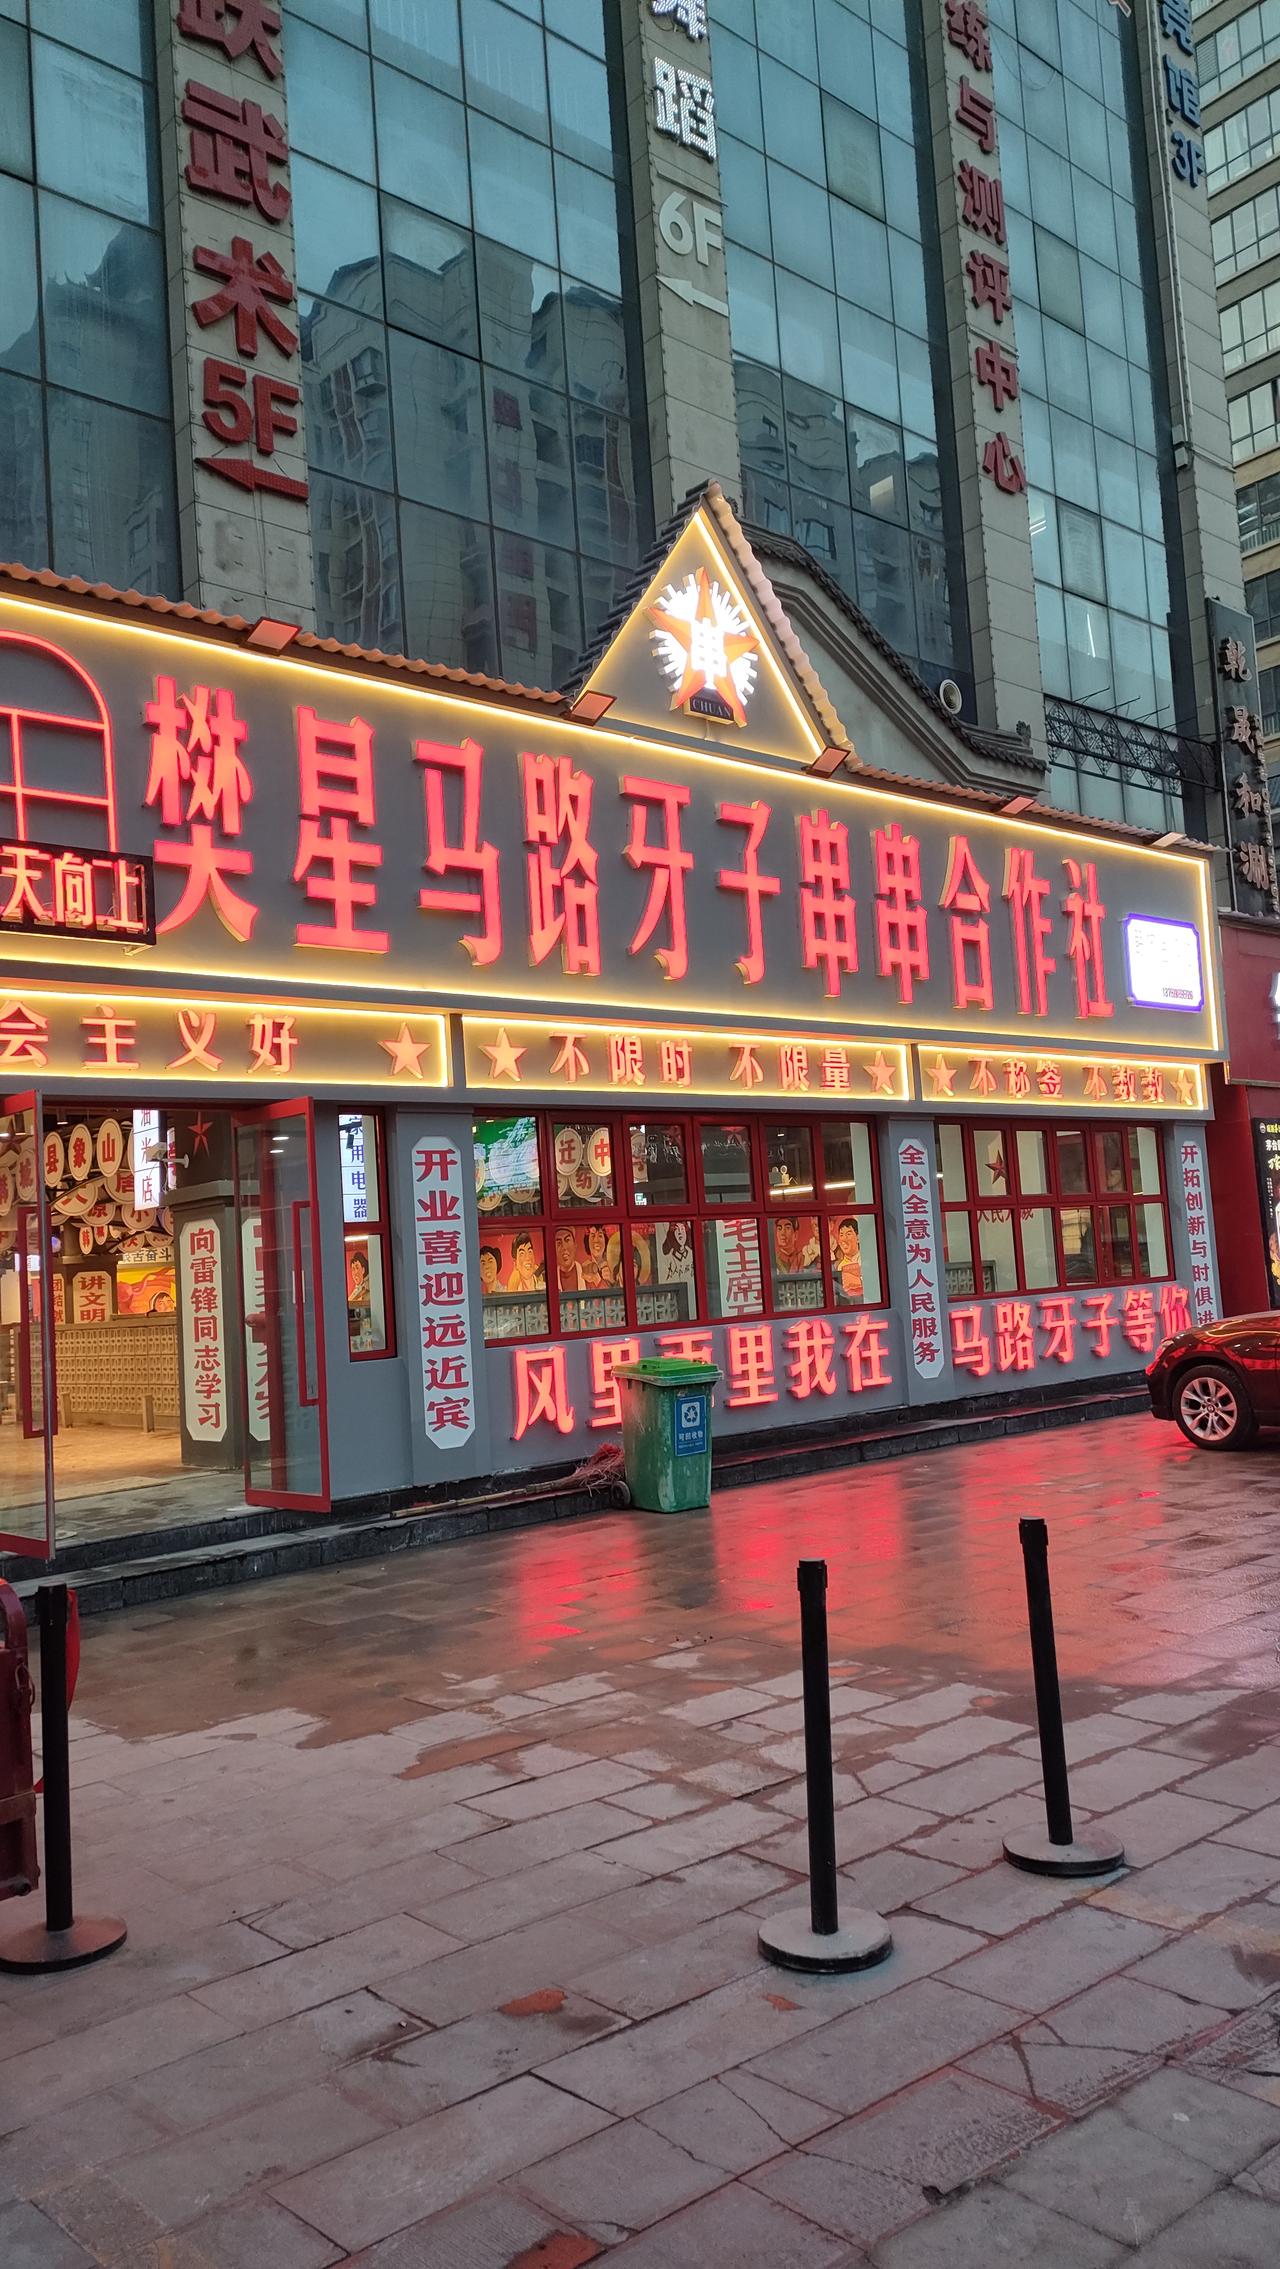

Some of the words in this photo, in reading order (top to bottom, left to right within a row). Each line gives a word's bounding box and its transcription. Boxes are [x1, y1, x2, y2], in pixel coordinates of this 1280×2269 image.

[1171, 130, 1205, 189] 3F
[658, 191, 723, 266] 6F
[944, 0, 1028, 495] 练与测评中心
[201, 357, 301, 456] 5F
[692, 698, 732, 718] CHUAN
[144, 674, 1115, 1020] 樊星马路牙子串串合作社
[0, 845, 146, 936] 天向上
[0, 1001, 299, 1074] 会主义好
[549, 1030, 694, 1088] 不限时
[728, 1042, 852, 1095] 不限量
[968, 1057, 1065, 1099] 不称签
[1081, 1064, 1167, 1104] 不数数
[101, 1132, 116, 1163] 山
[594, 1137, 611, 1168] 中
[898, 1144, 941, 1365] 全心全意为人民服务
[1180, 1144, 1216, 1326] 开拓创新与时俱进
[78, 1275, 107, 1323] 讲文明
[189, 1227, 223, 1430] 向雷锋同志学习
[413, 1147, 472, 1434] 开业喜迎远近宾
[950, 1284, 1194, 1378] 马路牙子等你
